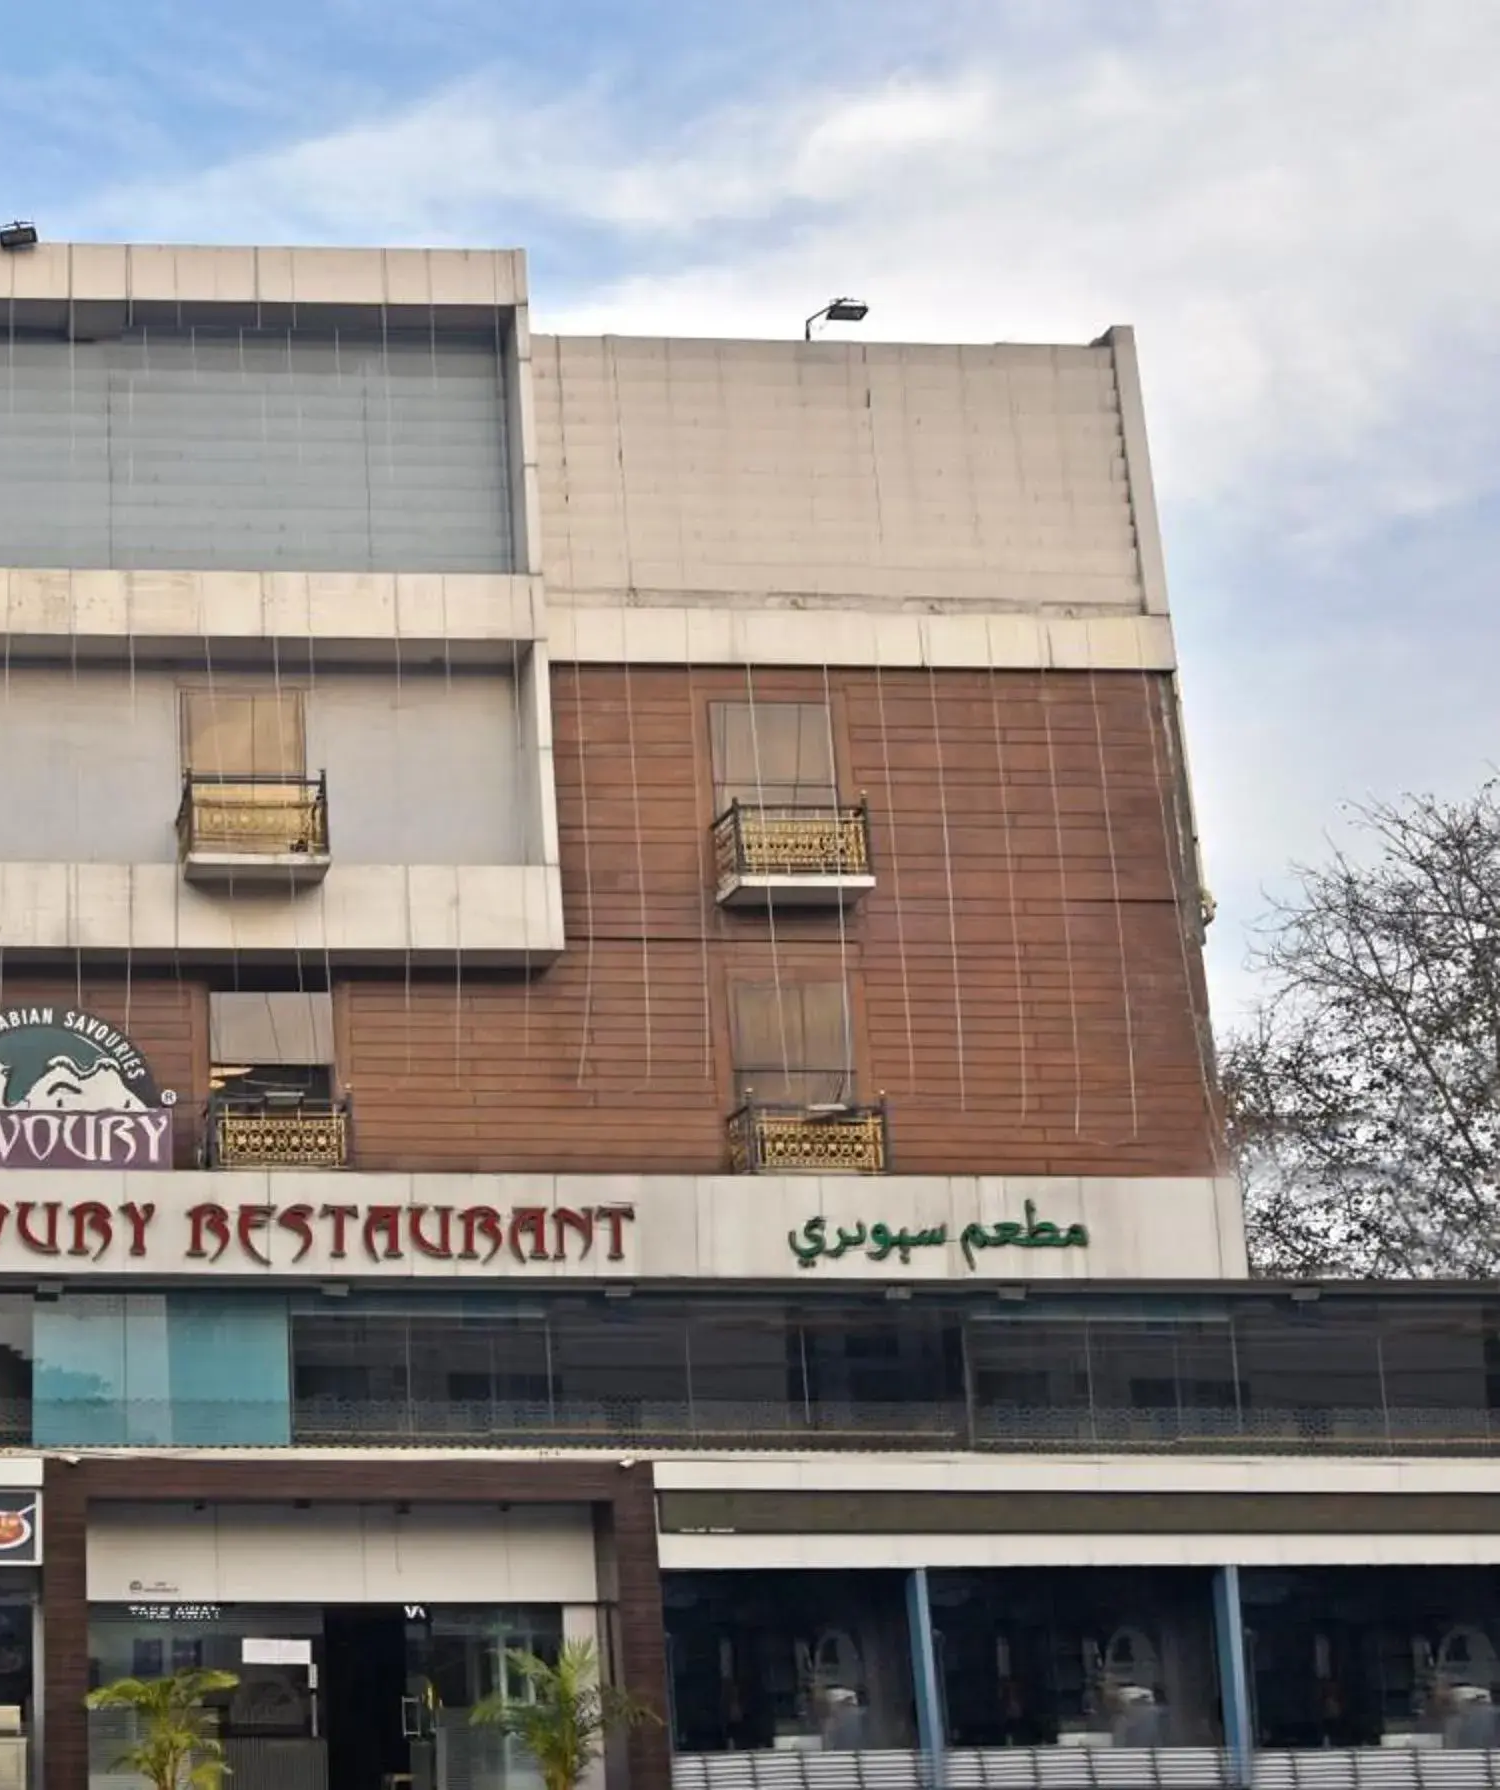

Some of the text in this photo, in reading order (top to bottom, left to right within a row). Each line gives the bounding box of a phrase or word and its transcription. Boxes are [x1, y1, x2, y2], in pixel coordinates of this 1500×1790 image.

[63, 1010, 147, 1081] SAVOURIES
[184, 1202, 636, 1267] RESTAURANT
[959, 1197, 1090, 1272] مطعم
